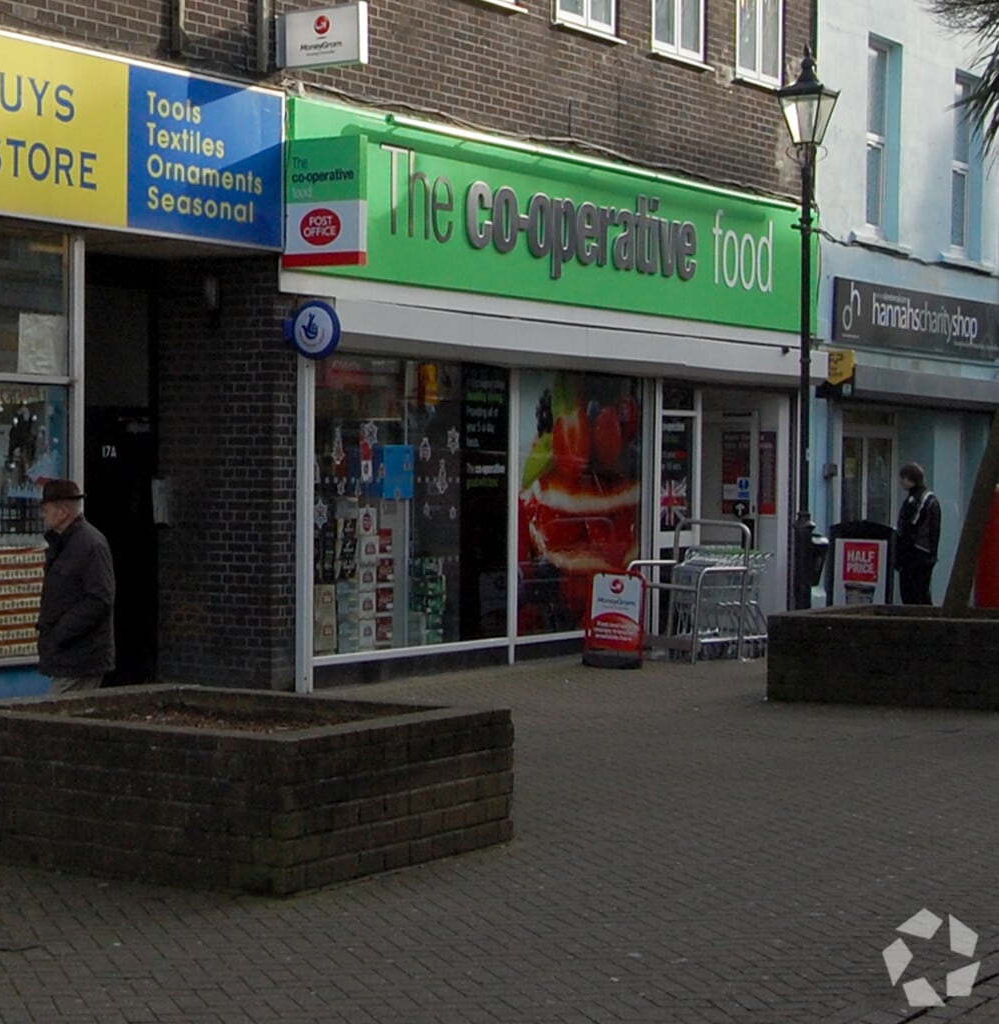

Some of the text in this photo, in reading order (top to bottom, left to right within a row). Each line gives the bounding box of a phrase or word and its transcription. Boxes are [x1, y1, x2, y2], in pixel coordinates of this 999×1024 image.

[147, 90, 201, 124] Tools
[147, 122, 224, 158] Textiles
[147, 154, 263, 195] Ornaments
[292, 169, 354, 184] co-operative
[148, 187, 254, 223] Seasonal
[309, 215, 332, 227] POST
[380, 144, 774, 293] The co-operative food
[303, 226, 337, 237] OFFICE
[102, 445, 117, 458] 17A
[847, 549, 876, 562] HALF
[847, 562, 874, 574] PRICE
